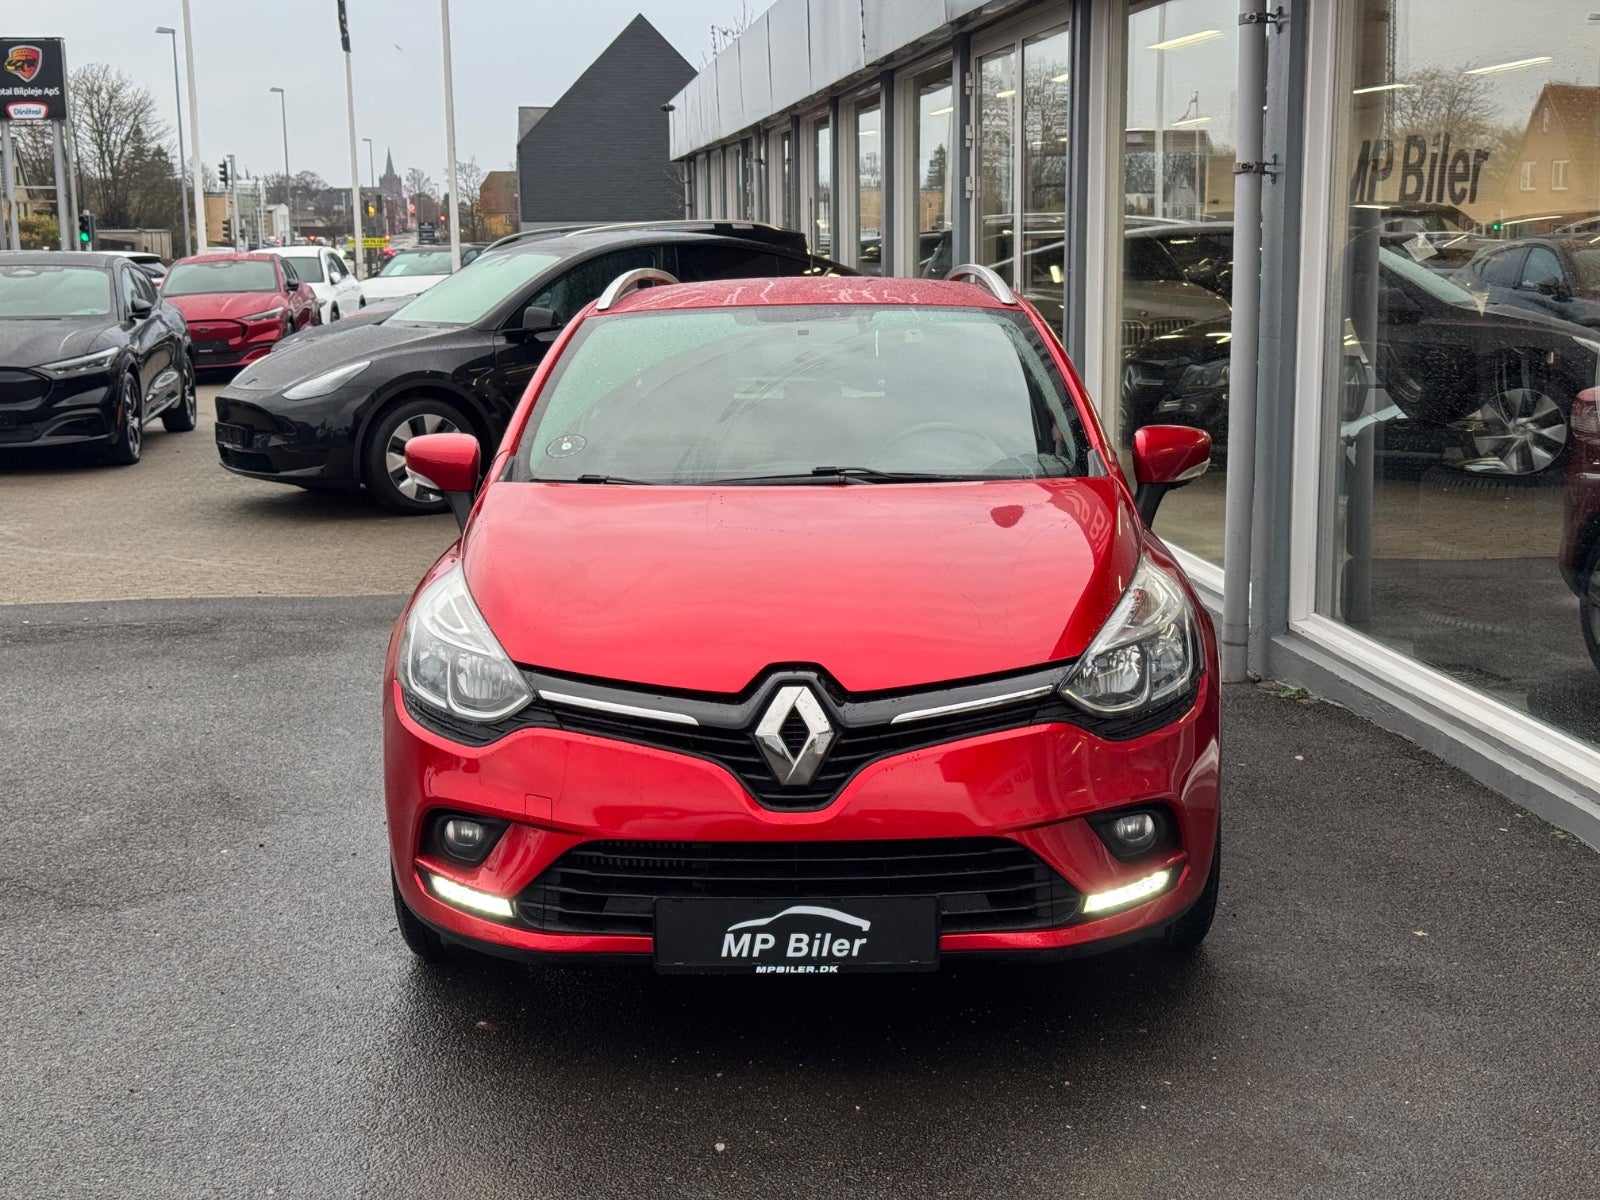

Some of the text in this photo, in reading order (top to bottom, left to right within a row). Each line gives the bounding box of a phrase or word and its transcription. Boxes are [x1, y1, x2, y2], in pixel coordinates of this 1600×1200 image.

[14, 87, 42, 96] Bilpleje
[44, 87, 59, 96] ApS
[1398, 131, 1490, 206] Biler
[721, 933, 868, 958] MP Biler
[755, 965, 839, 974] MPBILER.DK
